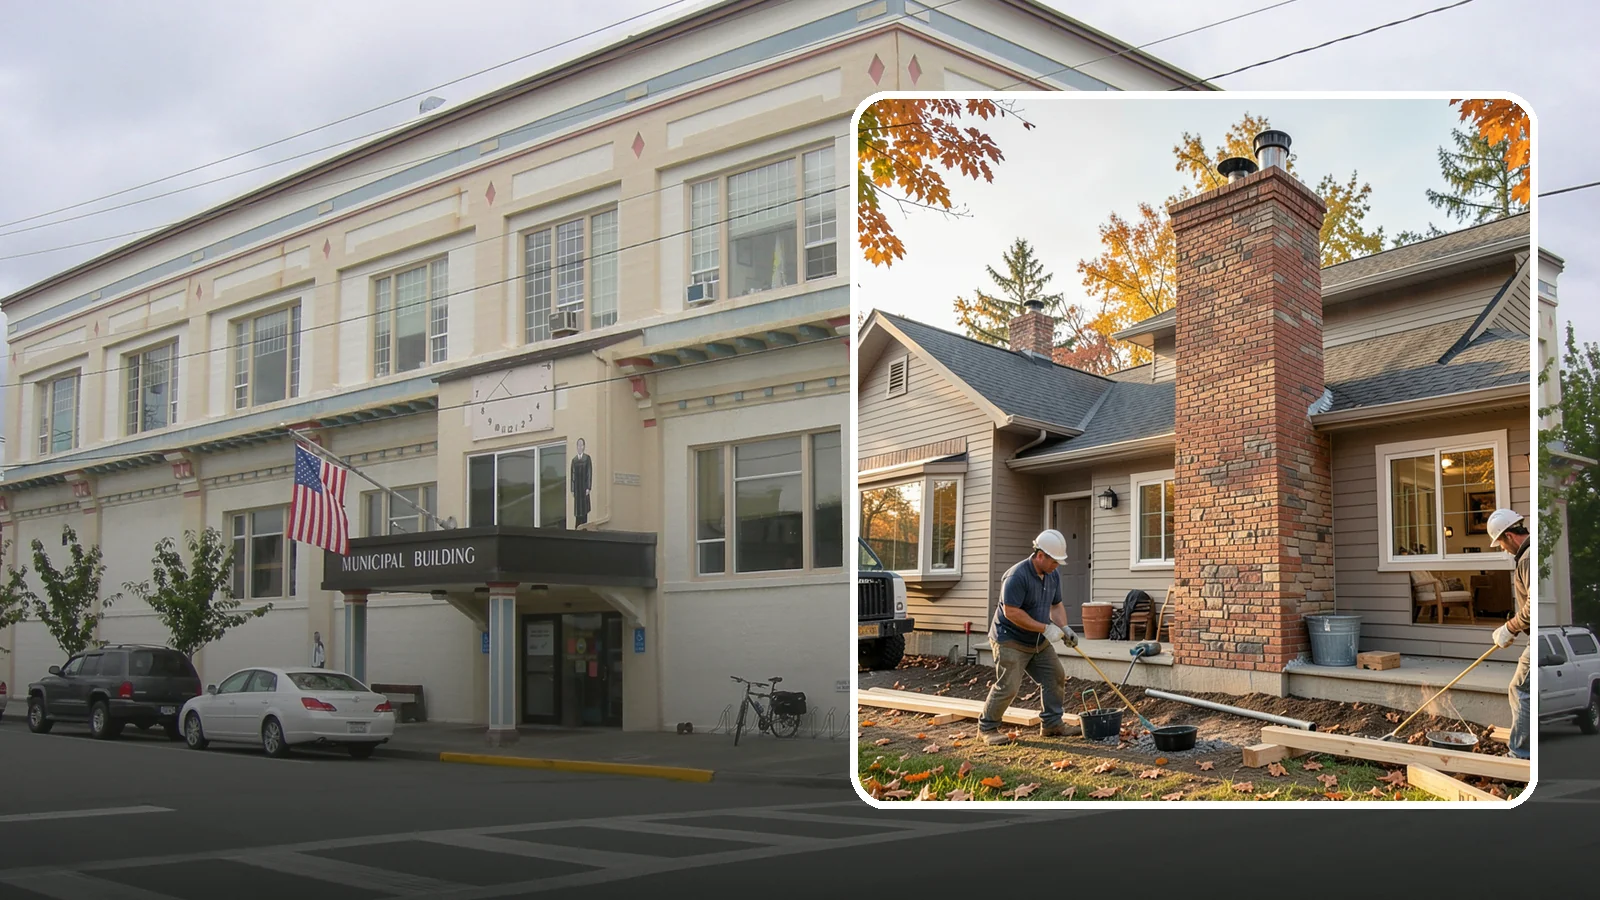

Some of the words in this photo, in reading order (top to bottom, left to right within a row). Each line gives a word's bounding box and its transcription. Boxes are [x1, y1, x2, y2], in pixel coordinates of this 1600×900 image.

[480, 407, 485, 415] 8
[488, 417, 492, 425] 9
[507, 425, 513, 433] 12
[521, 420, 526, 428] 2
[529, 414, 533, 422] 3
[536, 402, 540, 410] 4
[342, 552, 405, 572] MUNICIPAL
[414, 546, 475, 567] BUILDING
